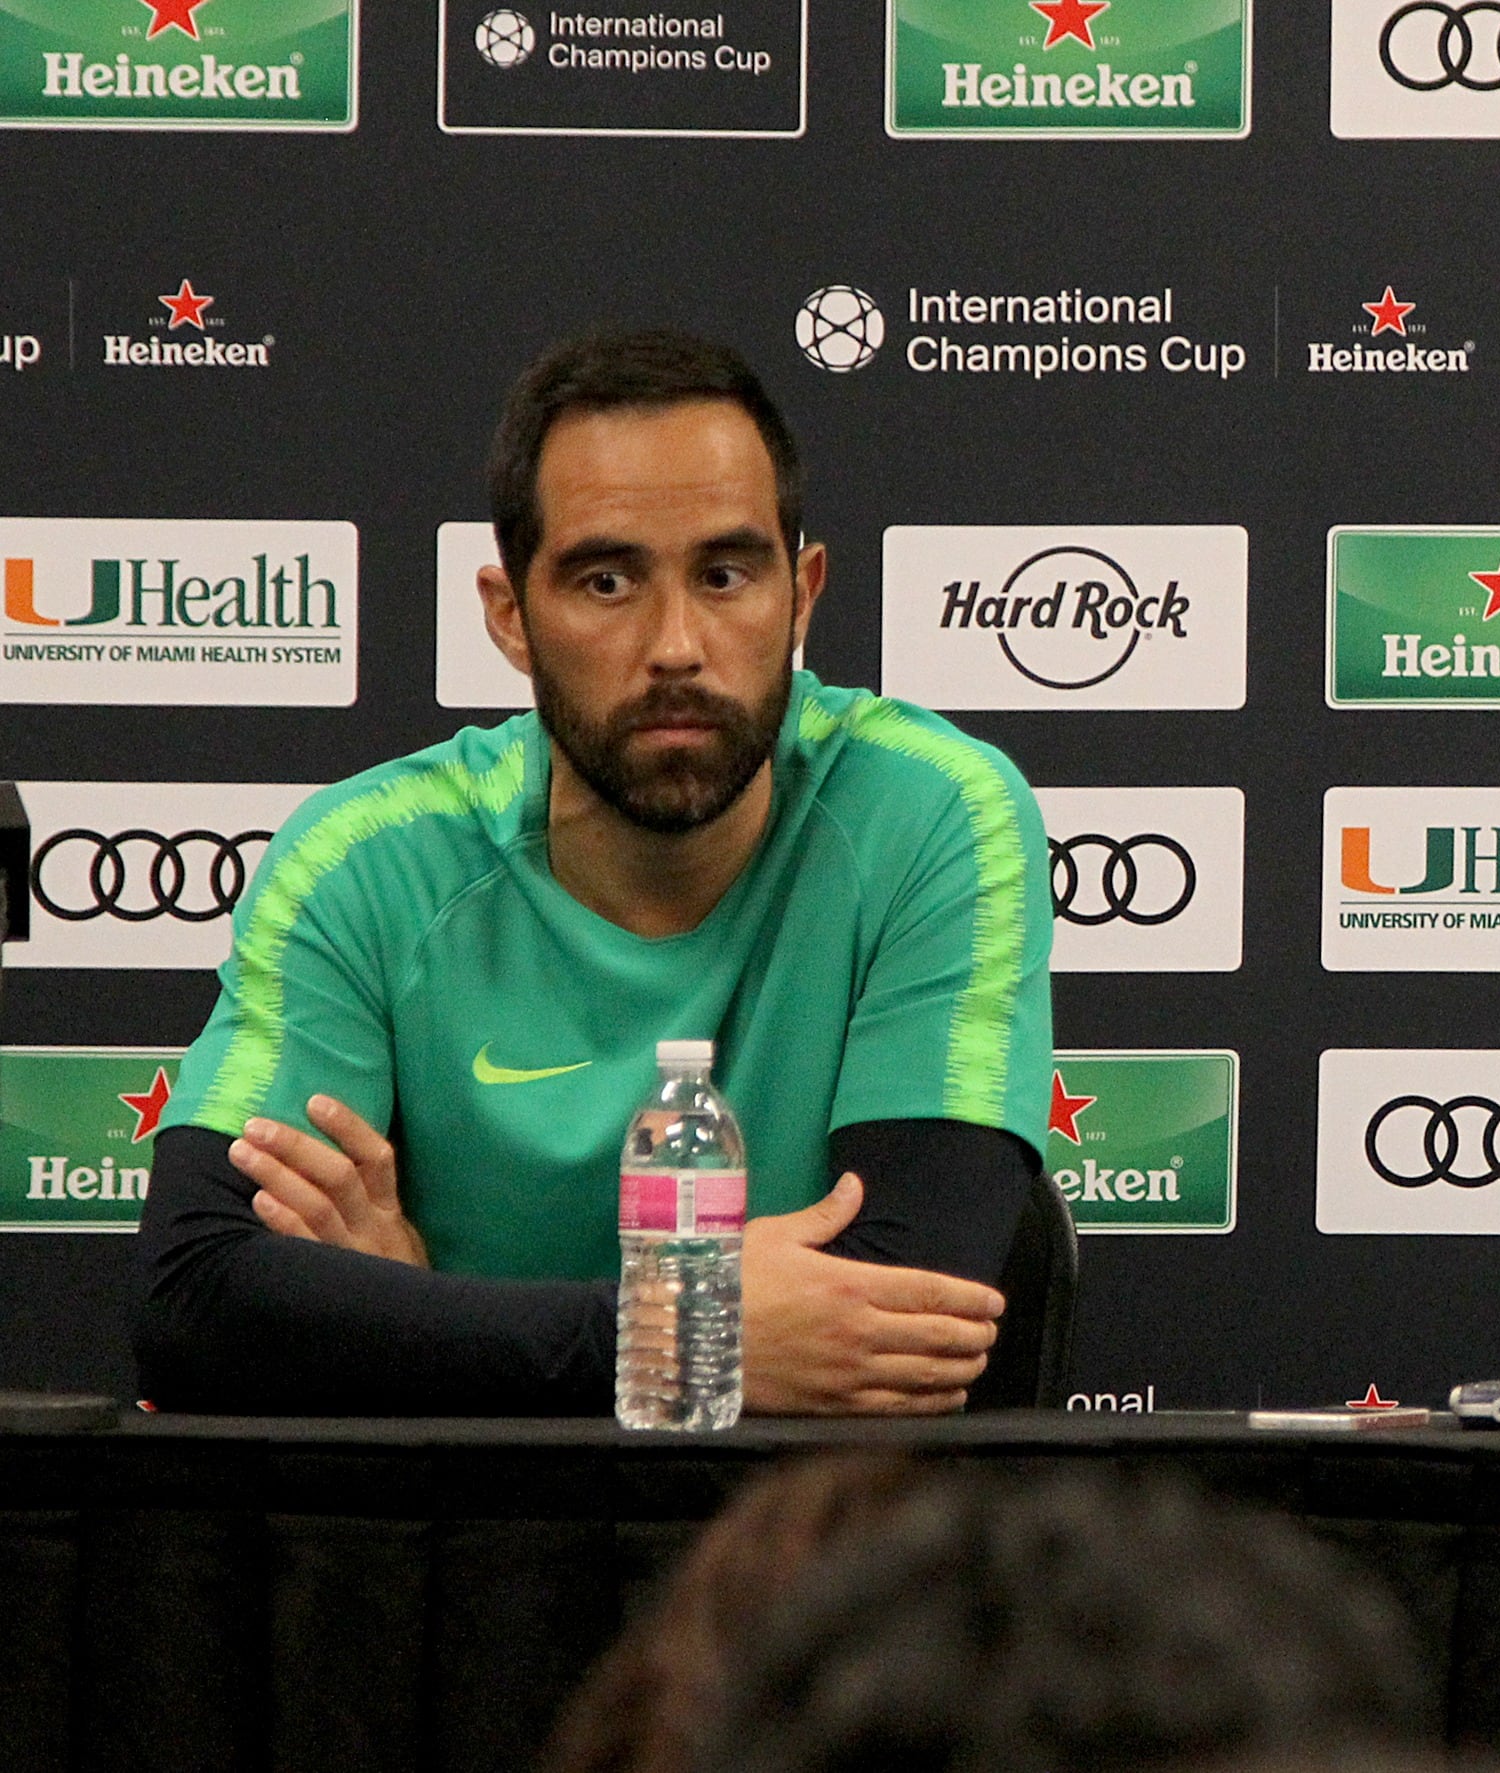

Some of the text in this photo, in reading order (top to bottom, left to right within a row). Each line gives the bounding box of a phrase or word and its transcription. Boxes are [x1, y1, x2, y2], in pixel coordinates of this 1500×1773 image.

[550, 13, 723, 40] International
[42, 53, 301, 99] Heineken
[549, 44, 771, 75] Champions Cup
[942, 64, 1196, 107] Heineken
[908, 287, 1172, 325] International
[103, 335, 269, 367] Heineken
[906, 336, 1246, 379] Champions Cup
[1308, 343, 1470, 372] Heineken
[940, 581, 1190, 639] Hard Rock
[3, 644, 341, 664] UNIVERSITY OF MIAMI HEALTH SYSTEM
[1339, 912, 1438, 930] UNIVERSITY
[1443, 912, 1465, 930] OF
[26, 1156, 149, 1200] Hein
[1052, 1159, 1180, 1202] eken
